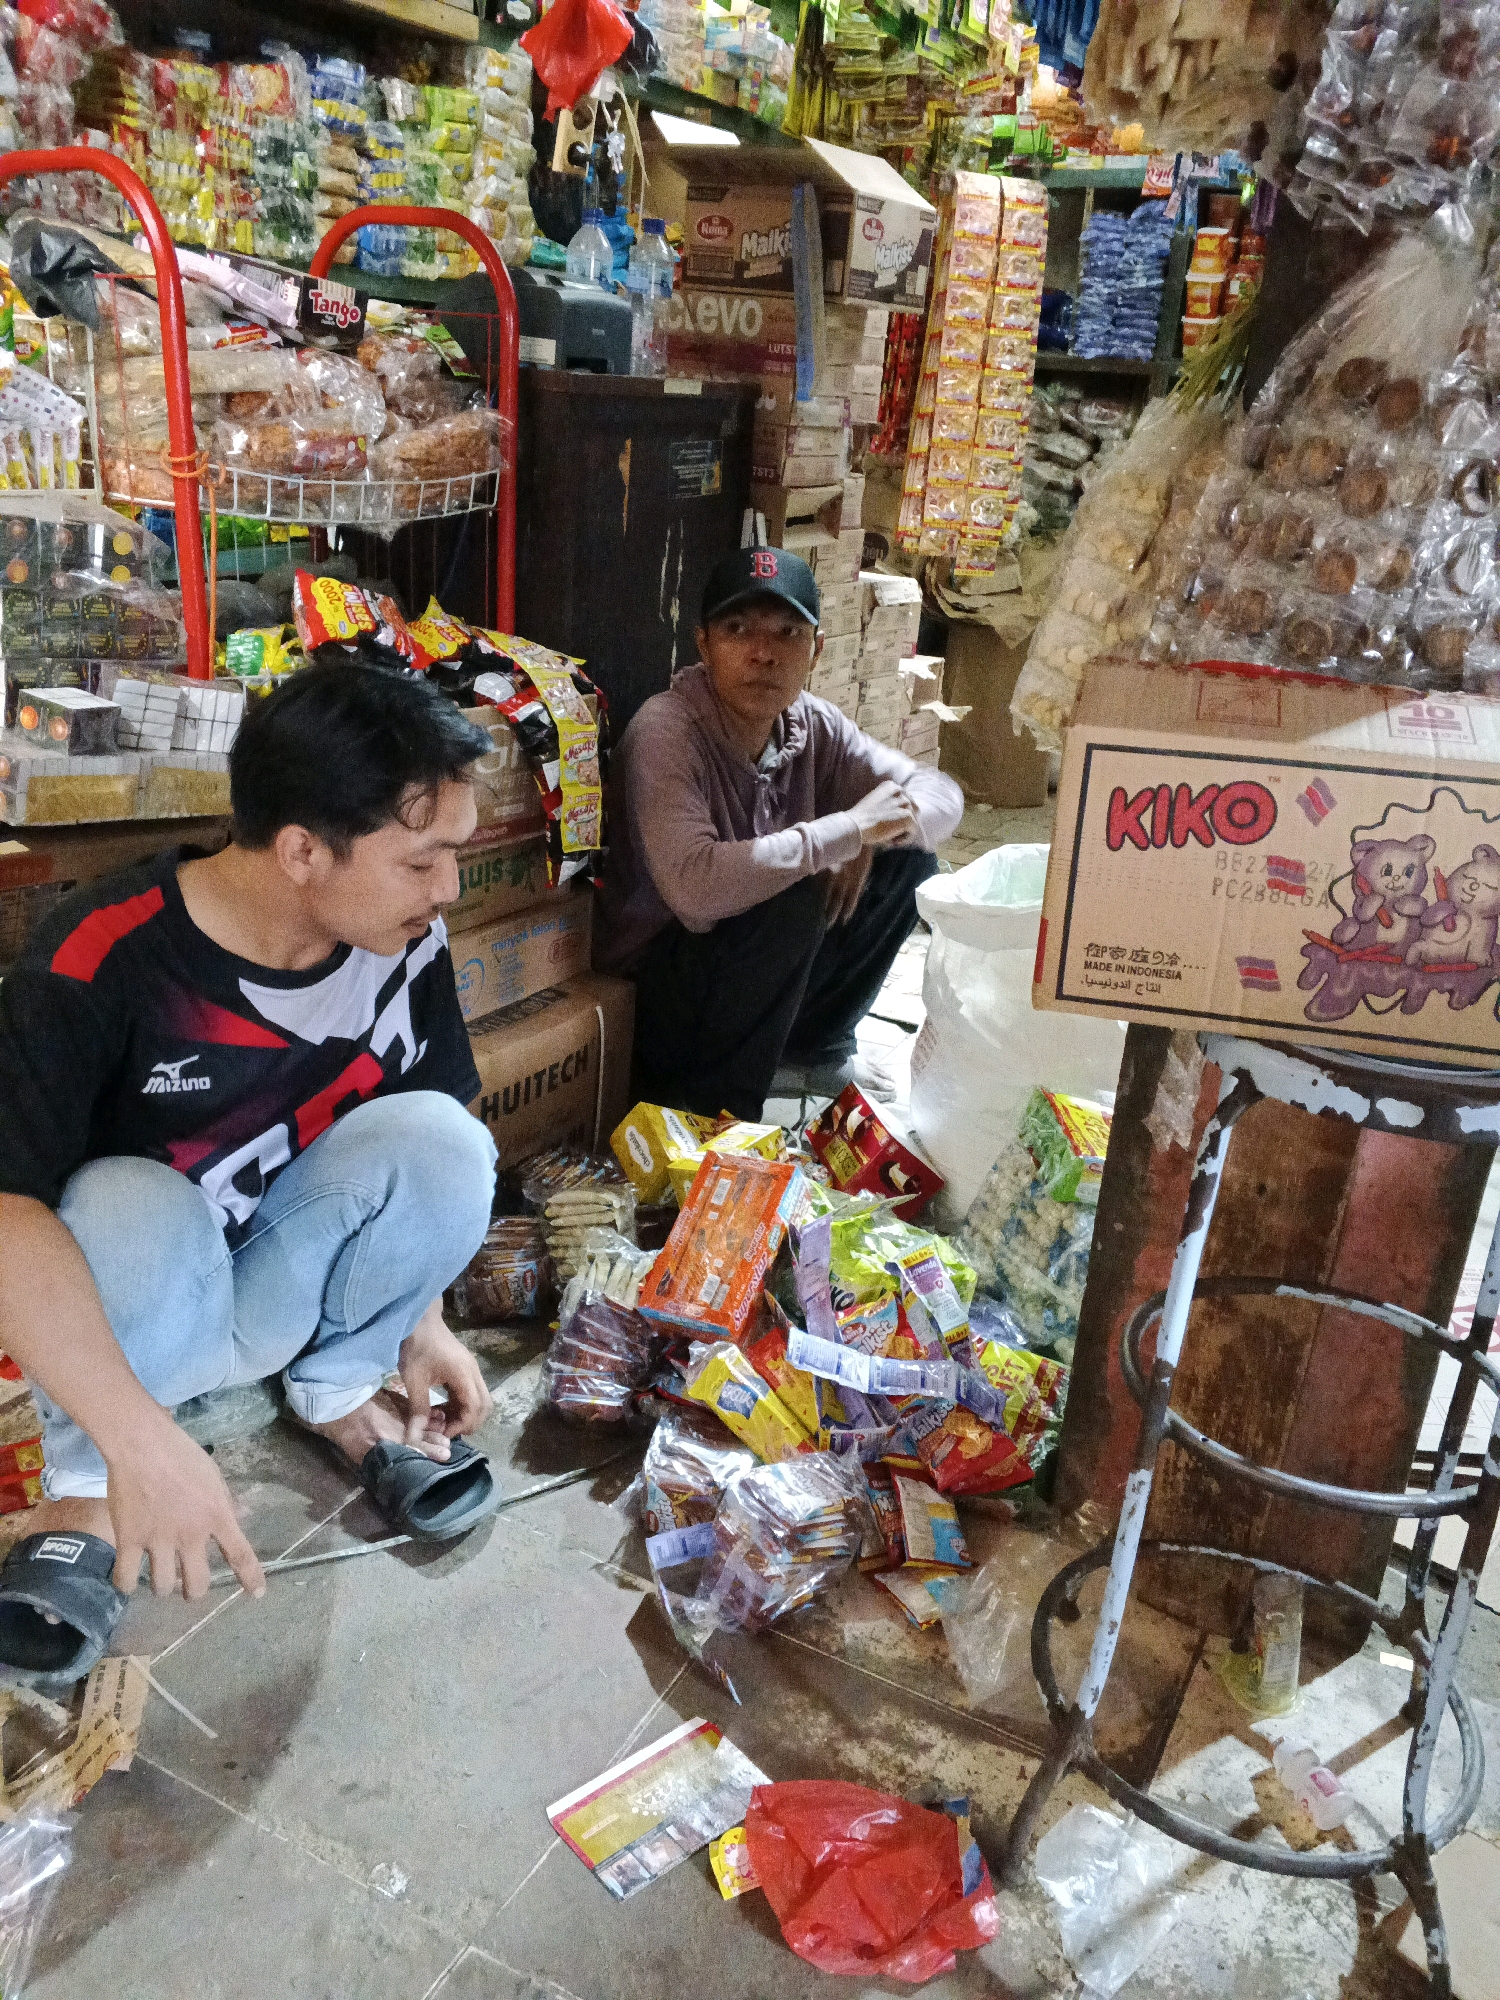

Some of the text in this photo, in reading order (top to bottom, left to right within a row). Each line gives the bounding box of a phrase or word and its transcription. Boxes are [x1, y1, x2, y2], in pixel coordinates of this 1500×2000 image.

[741, 222, 793, 260] Malki
[309, 289, 361, 328] Tango
[750, 552, 779, 578] B
[319, 579, 343, 606] 2000
[1402, 703, 1456, 720] 10
[1106, 780, 1278, 851] KIKO
[1083, 960, 1182, 981] MADE IN INDONESIA
[479, 1042, 590, 1125] HUITECH
[743, 1221, 766, 1263] Superstar
[734, 1251, 768, 1332] Superstar
[858, 1320, 894, 1356] alkist
[43, 1541, 78, 1555] SPORT
